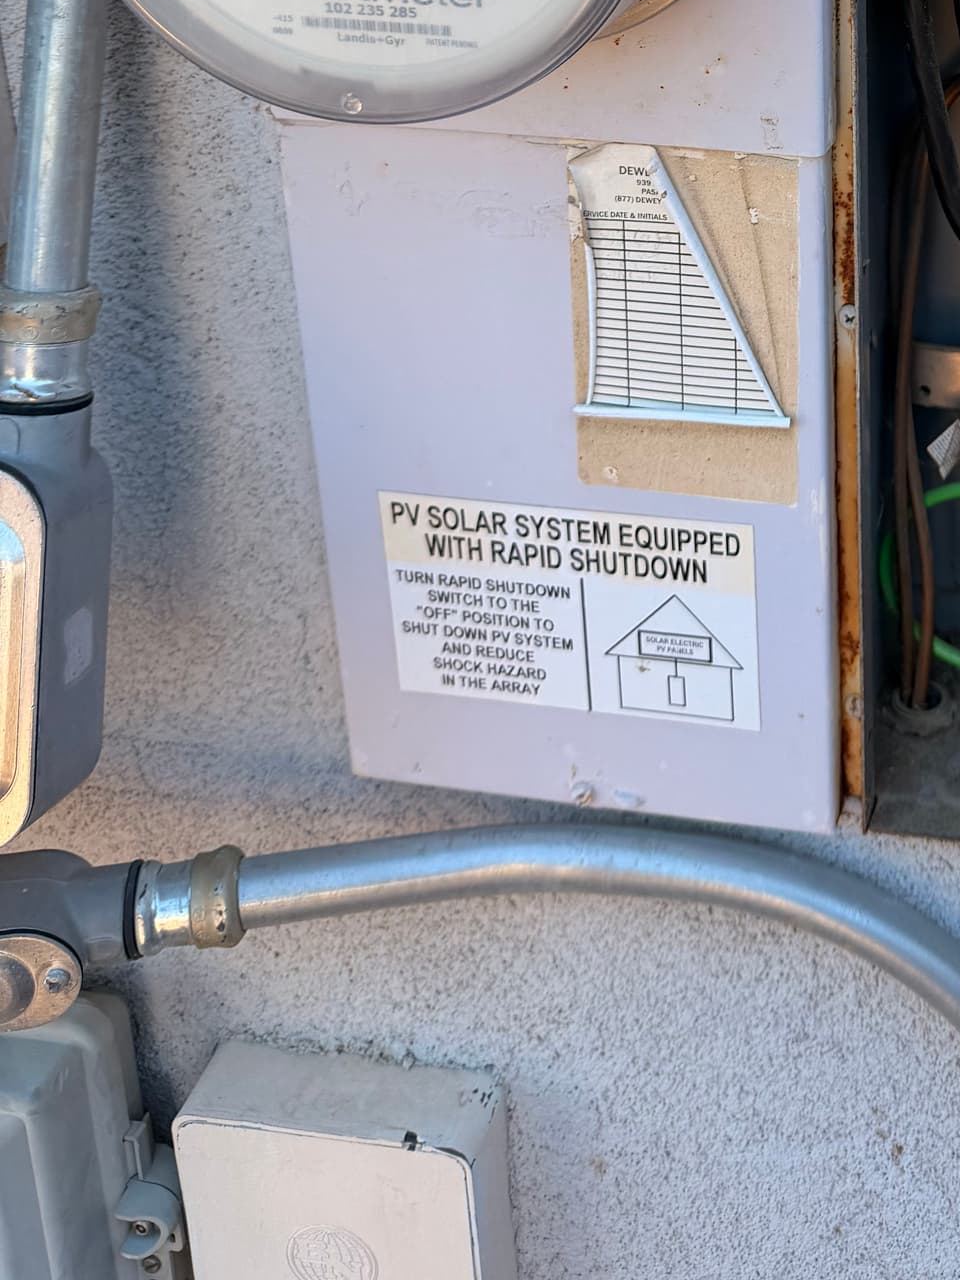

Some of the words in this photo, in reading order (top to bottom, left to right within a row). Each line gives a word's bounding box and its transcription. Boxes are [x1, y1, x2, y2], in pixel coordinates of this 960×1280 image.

[324, 2, 353, 15] 102
[356, 4, 385, 17] 235
[389, 6, 417, 19] 285
[337, 33, 405, 47] Landis+Gyr
[614, 195, 635, 203] (877)
[635, 196, 662, 204] DEWEY
[583, 210, 609, 218] ERVICE
[610, 211, 628, 219] DATE
[390, 502, 420, 525] PV
[428, 505, 508, 536] SOLAR
[516, 514, 612, 547] SYSTEM
[619, 523, 741, 557] EQUIPPED
[425, 533, 484, 562] WITH
[490, 540, 562, 570] RAPID
[570, 548, 709, 584] SHUTDOWN
[396, 569, 434, 587] TURN
[438, 573, 482, 591] RAPID
[485, 578, 571, 600] SHUTDOWN
[428, 589, 484, 609] SWITCH
[486, 595, 507, 610] TO
[510, 597, 540, 614] THE
[417, 604, 458, 622] "OFF"
[462, 609, 530, 630] POSITION
[533, 617, 555, 632] TO
[402, 620, 438, 638] SHUT
[443, 624, 488, 642] DOWN
[492, 628, 511, 643] PV
[514, 631, 574, 651] SYSTEM
[646, 635, 669, 644] SOLAR
[670, 639, 704, 648] ELECTRIC
[442, 641, 473, 656] AND
[476, 645, 535, 664] REDUCE
[433, 656, 483, 675] SHOCK
[487, 662, 547, 681] HAZARD
[442, 674, 457, 687] IN
[460, 676, 488, 691] THE
[491, 679, 541, 696] ARRAY
